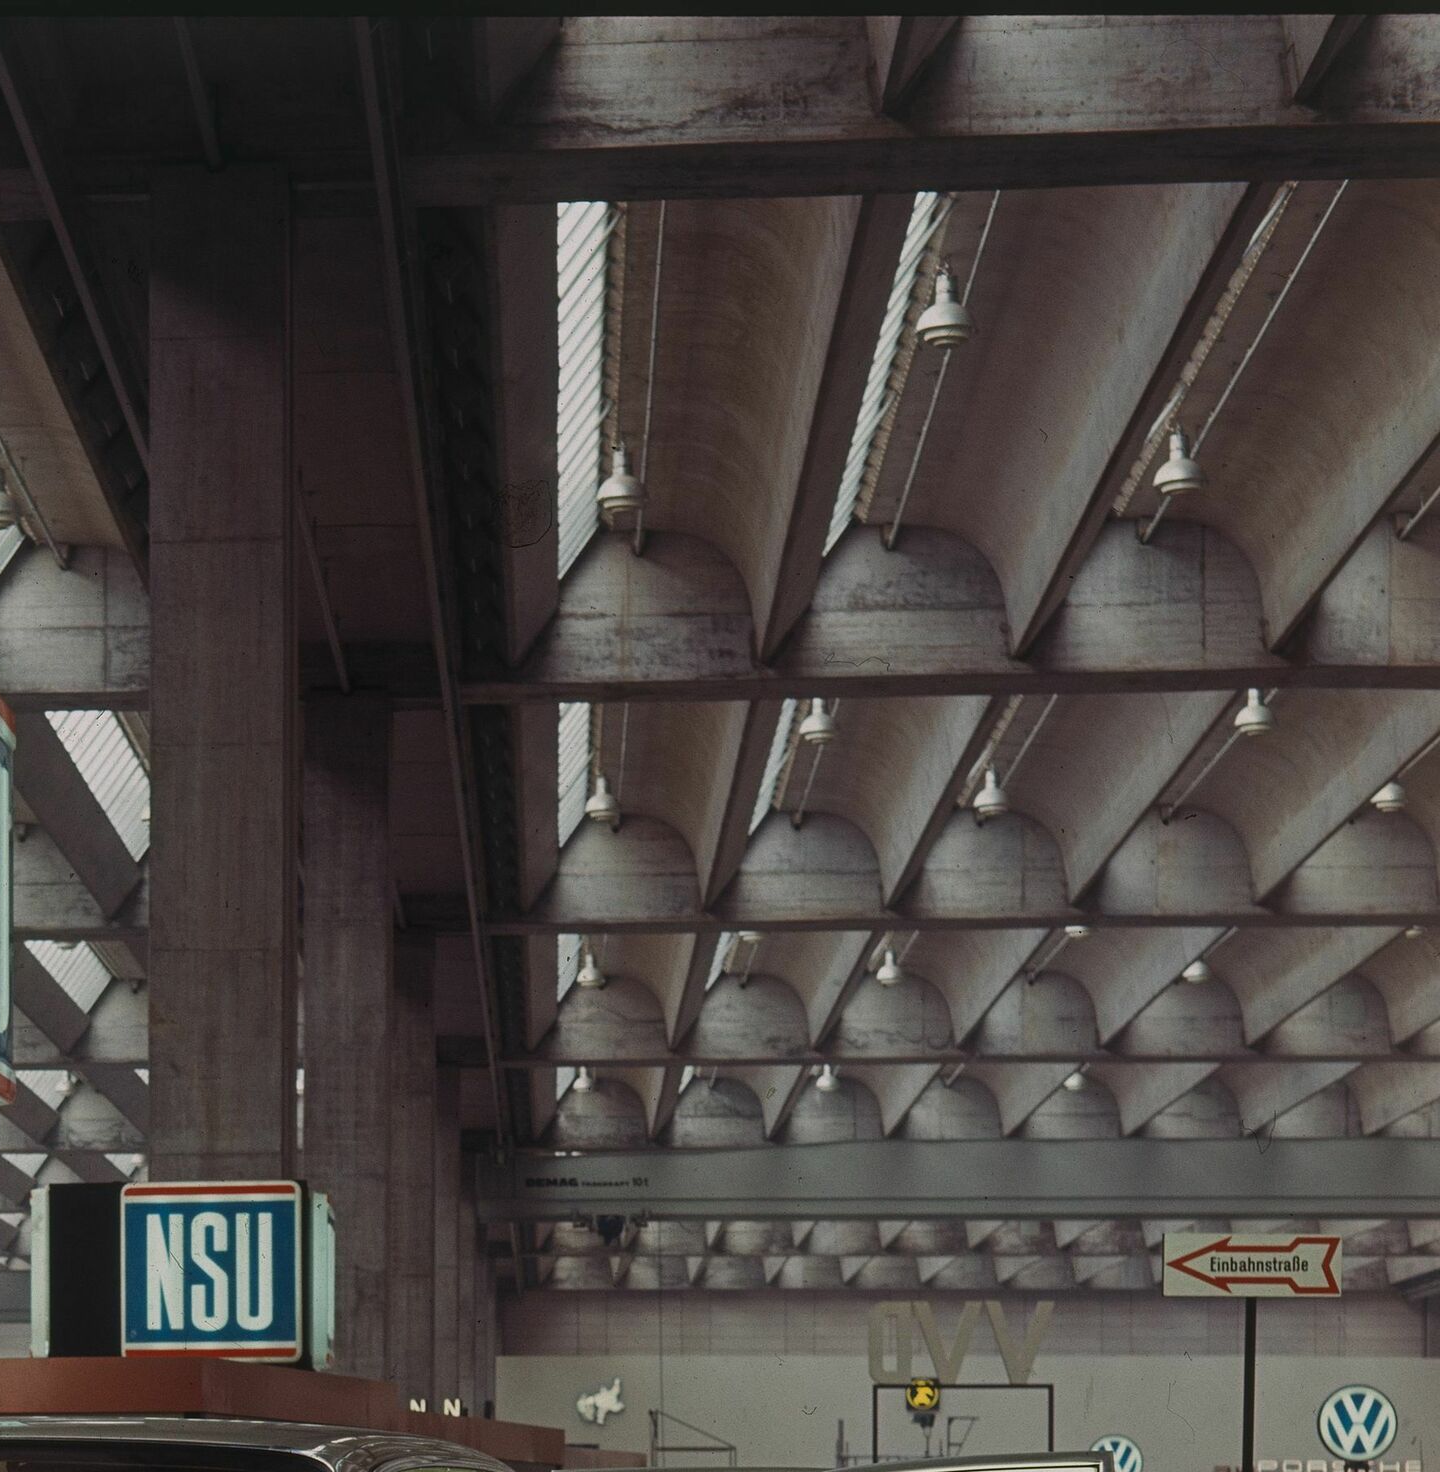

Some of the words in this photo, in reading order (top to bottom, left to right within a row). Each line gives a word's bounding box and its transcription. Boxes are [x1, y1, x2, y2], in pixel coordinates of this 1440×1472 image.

[146, 1211, 274, 1332] NSU
[1210, 1256, 1309, 1273] Einbahnstraße
[1321, 1387, 1394, 1459] VW
